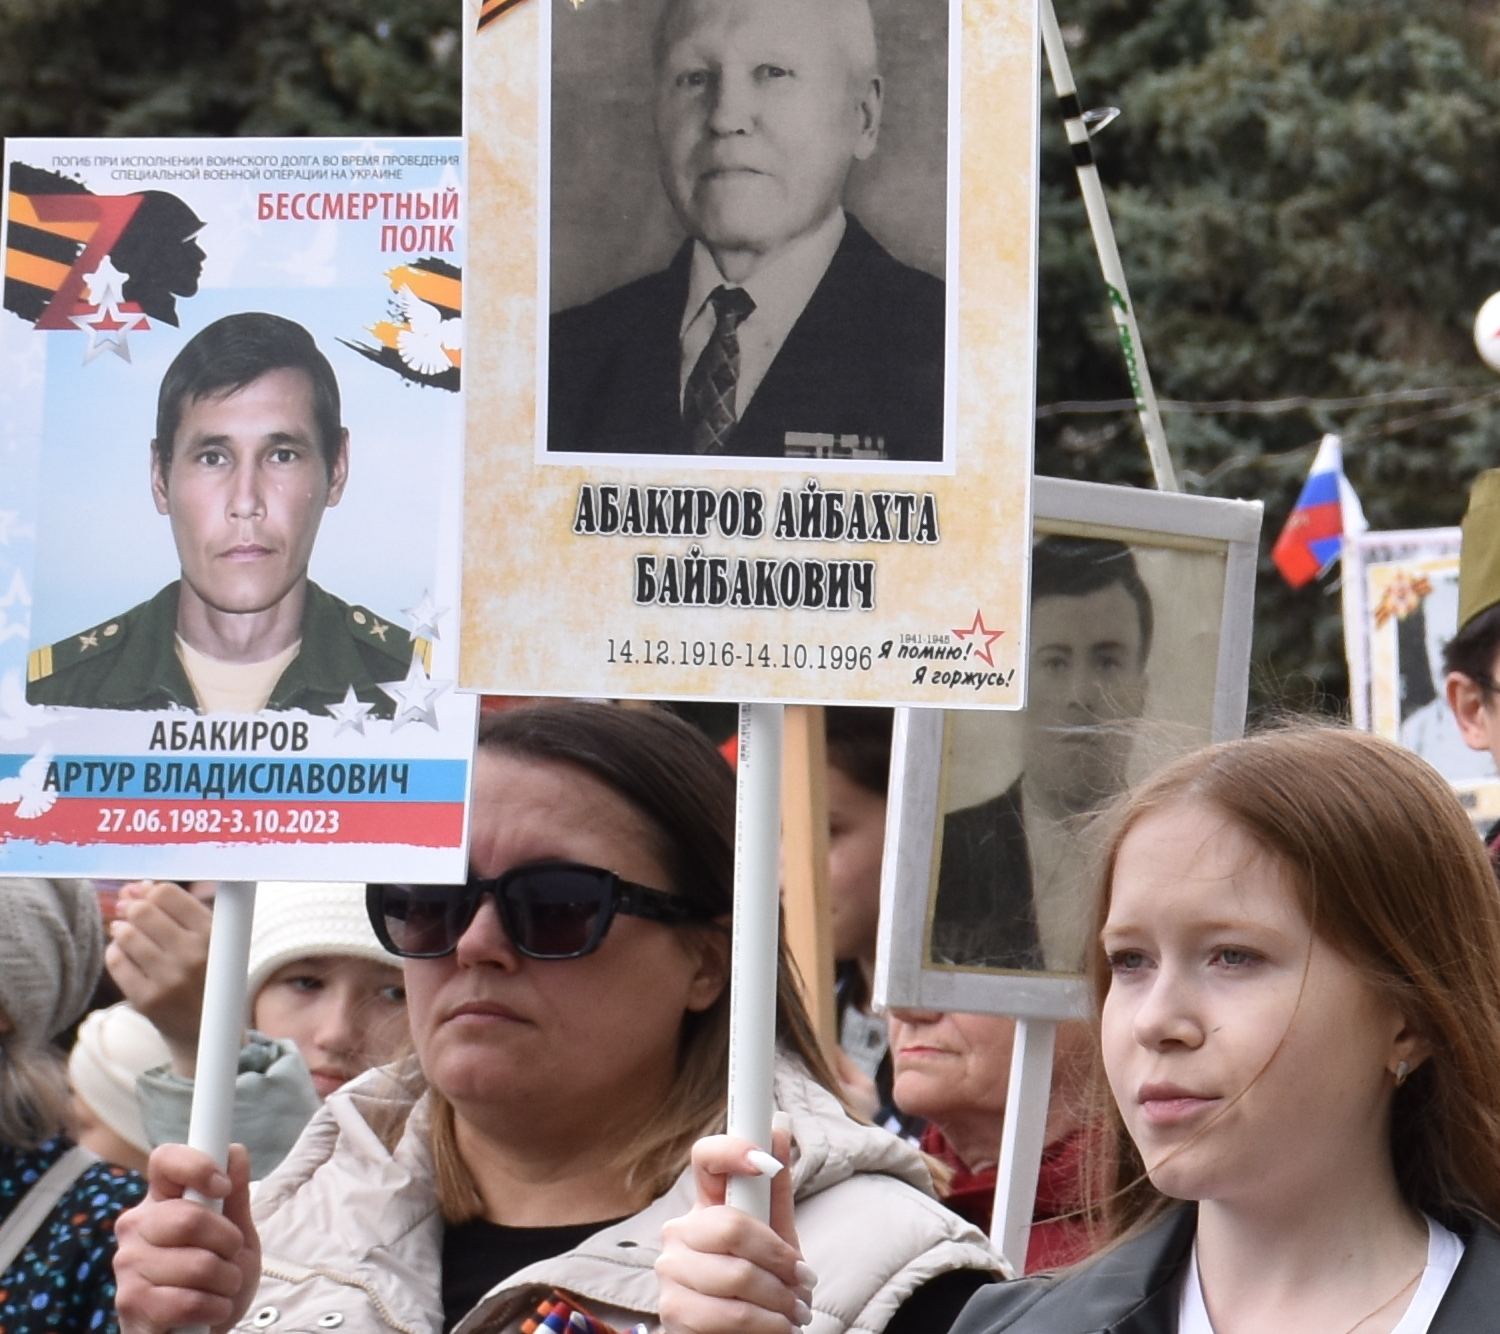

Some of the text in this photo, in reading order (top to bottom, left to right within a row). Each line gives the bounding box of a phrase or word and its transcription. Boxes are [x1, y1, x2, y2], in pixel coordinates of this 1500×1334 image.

[52, 155, 460, 169] ПОГИБ ПРИ ИСПОЛНЕНИИ ВОИНСКОГО ДОЛГА ВО ВРЕМЯ ПРОВЕДЕНИЯ
[111, 168, 404, 182] СПЕЦИАЛЬНОЙ ВОЕННОЙ ОПЕРАЦИИ НА УКРАИНЕ
[257, 186, 460, 221] БЕССМЕРТНЫЙ
[380, 225, 456, 253] ПОЛК
[574, 479, 940, 543] АБАКИРОВ АЙБАХТА
[635, 546, 877, 610] БАЙБАКОВИЧ
[606, 638, 873, 672] 14.12.1916-14.10.1996
[878, 641, 972, 662] Я помню!
[912, 666, 1015, 690] Я горжусь!
[148, 720, 310, 752] АБАКИРОВ
[42, 761, 410, 800] АРТУР ВЛАДИСЛАВОВИЧ
[97, 808, 341, 834] 27.06.1982-3.10.2023
